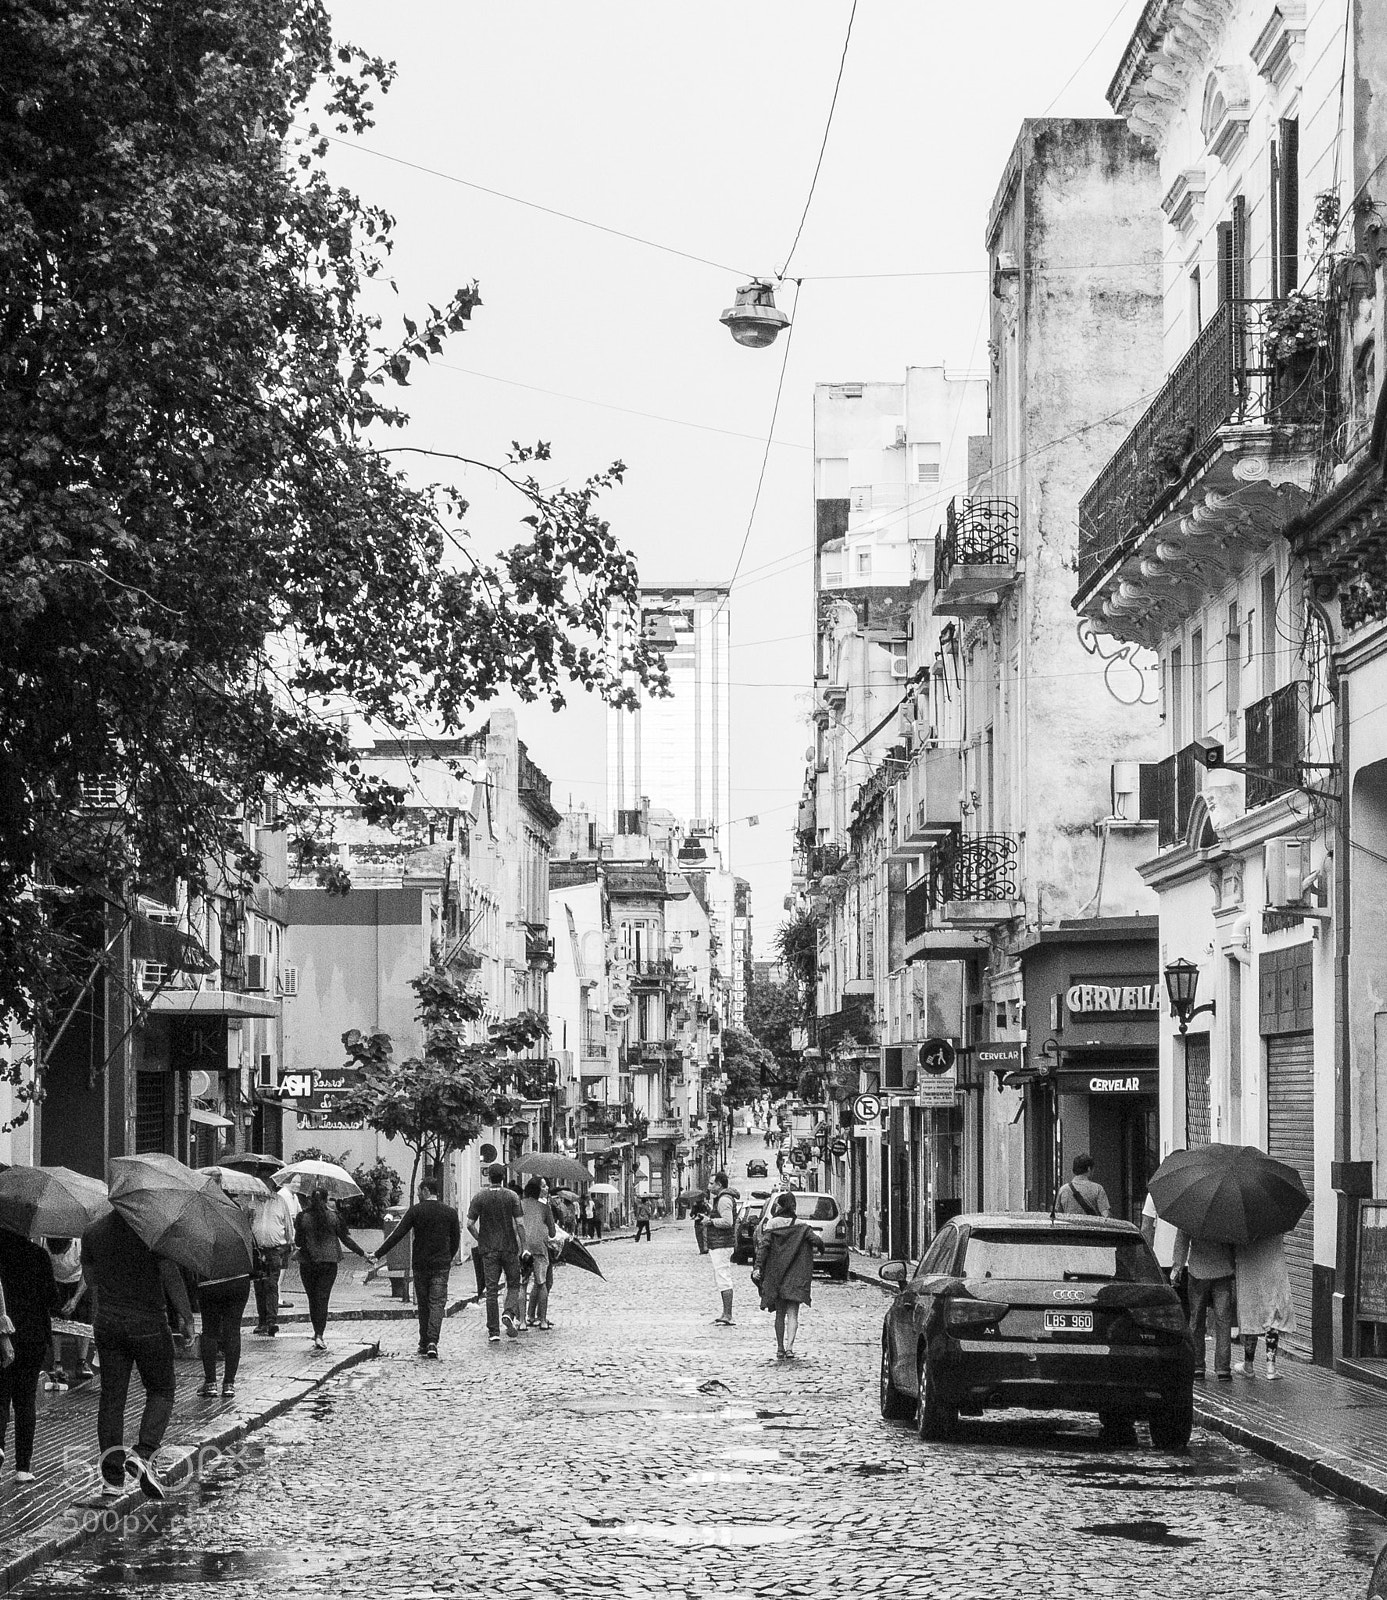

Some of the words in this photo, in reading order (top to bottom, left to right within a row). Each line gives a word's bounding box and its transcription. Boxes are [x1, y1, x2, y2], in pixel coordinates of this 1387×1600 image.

[980, 1050, 1019, 1060] CERVELAR
[1089, 1077, 1140, 1092] CERVELAR
[1046, 1315, 1066, 1327] LBS
[1071, 1316, 1091, 1328] 960
